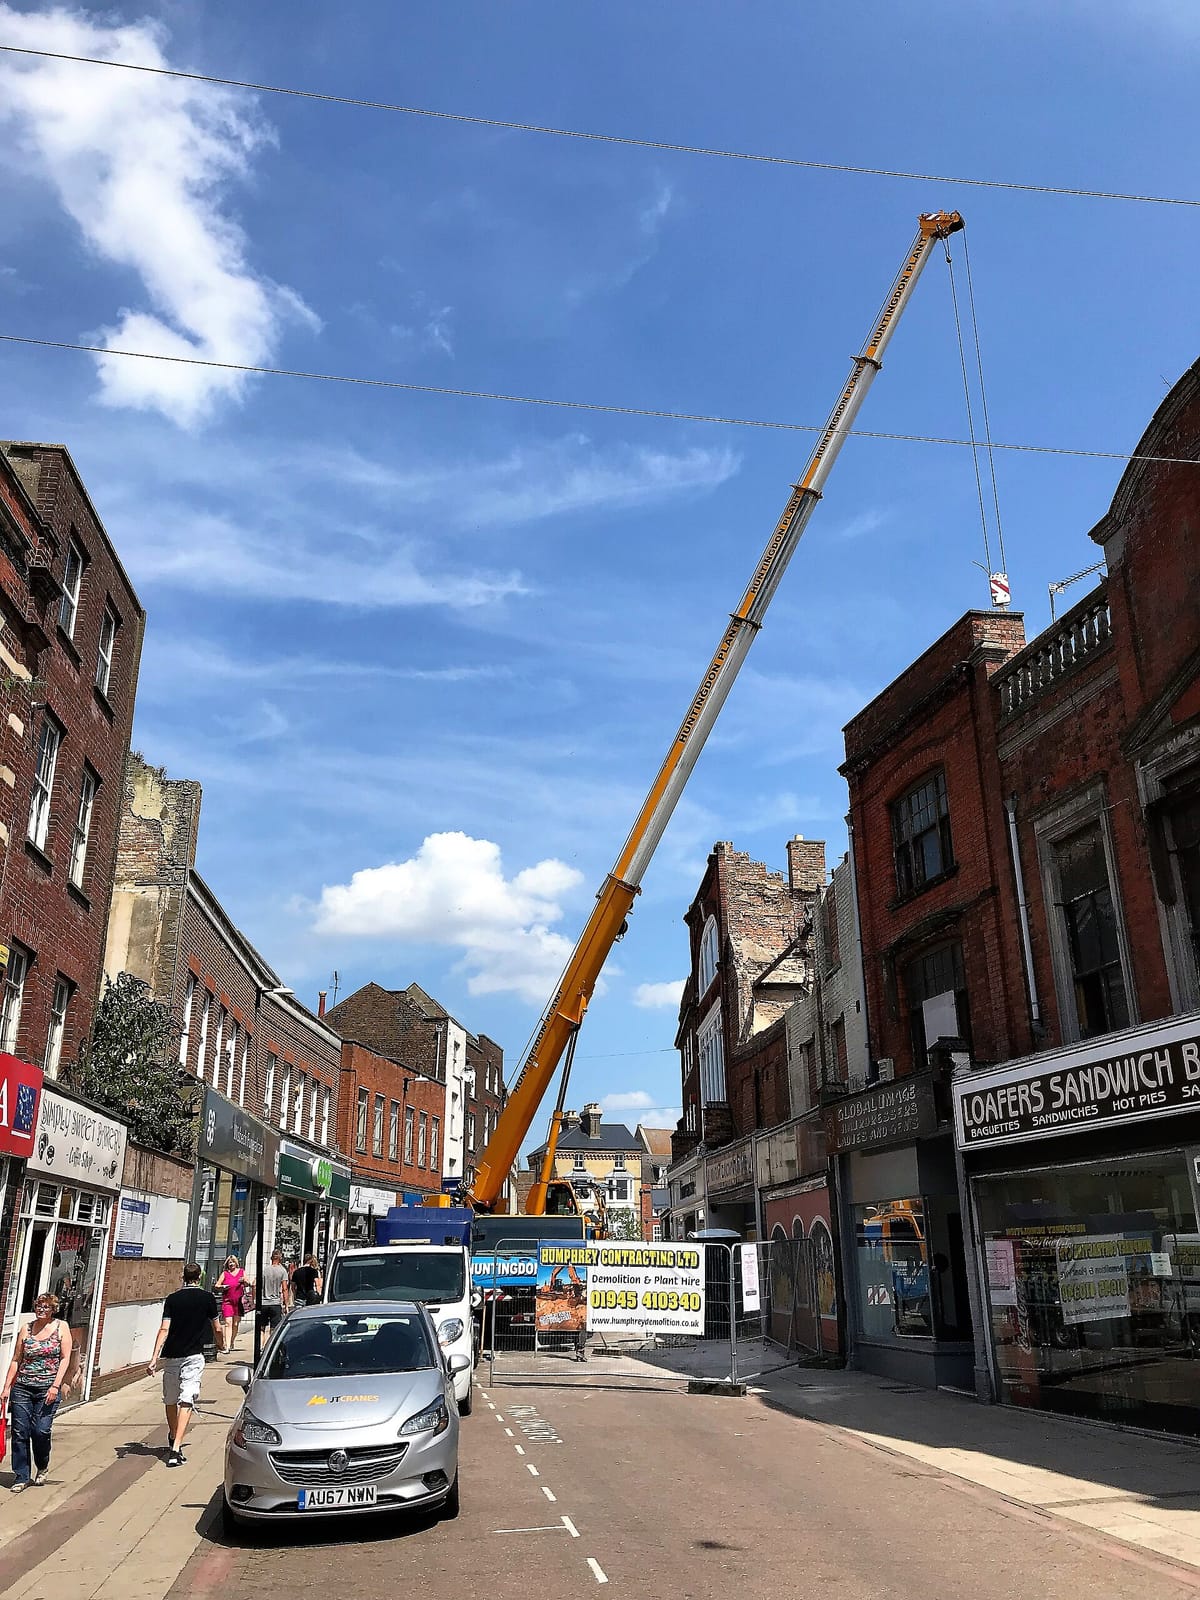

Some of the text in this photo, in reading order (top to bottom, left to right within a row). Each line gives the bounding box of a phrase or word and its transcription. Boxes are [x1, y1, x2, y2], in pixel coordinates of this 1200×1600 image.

[869, 236, 928, 347] HUNTINGDON PLANT
[814, 362, 865, 460] HUNTINGDON PLANT
[750, 493, 801, 594] HUNTINGDON PLANT
[679, 621, 741, 743] HUNTINGDON PLANT
[514, 988, 564, 1094] HUNTINGDON PLANT
[837, 1083, 916, 1122] GLOBAL IMAGE
[962, 1081, 1045, 1127] LOAFERS
[1050, 1048, 1174, 1109] SANDWICH
[41, 1099, 72, 1138] SIMPLY
[970, 1120, 1021, 1138] BAGUETTES
[1032, 1104, 1099, 1127] SANDWICHES
[1113, 1096, 1135, 1111] HOT
[1140, 1090, 1167, 1107] PIES
[837, 1131, 868, 1148] LADIES
[870, 1126, 888, 1141] AND
[540, 1248, 699, 1270] HUMPHREY CONTRACTING LTD
[592, 1274, 701, 1287] Demolition & Plant Hire
[590, 1290, 701, 1312] 01945 410340
[591, 1317, 700, 1328] www.humphreydemolition.co.uk
[308, 1487, 374, 1506] AU67 NWN
